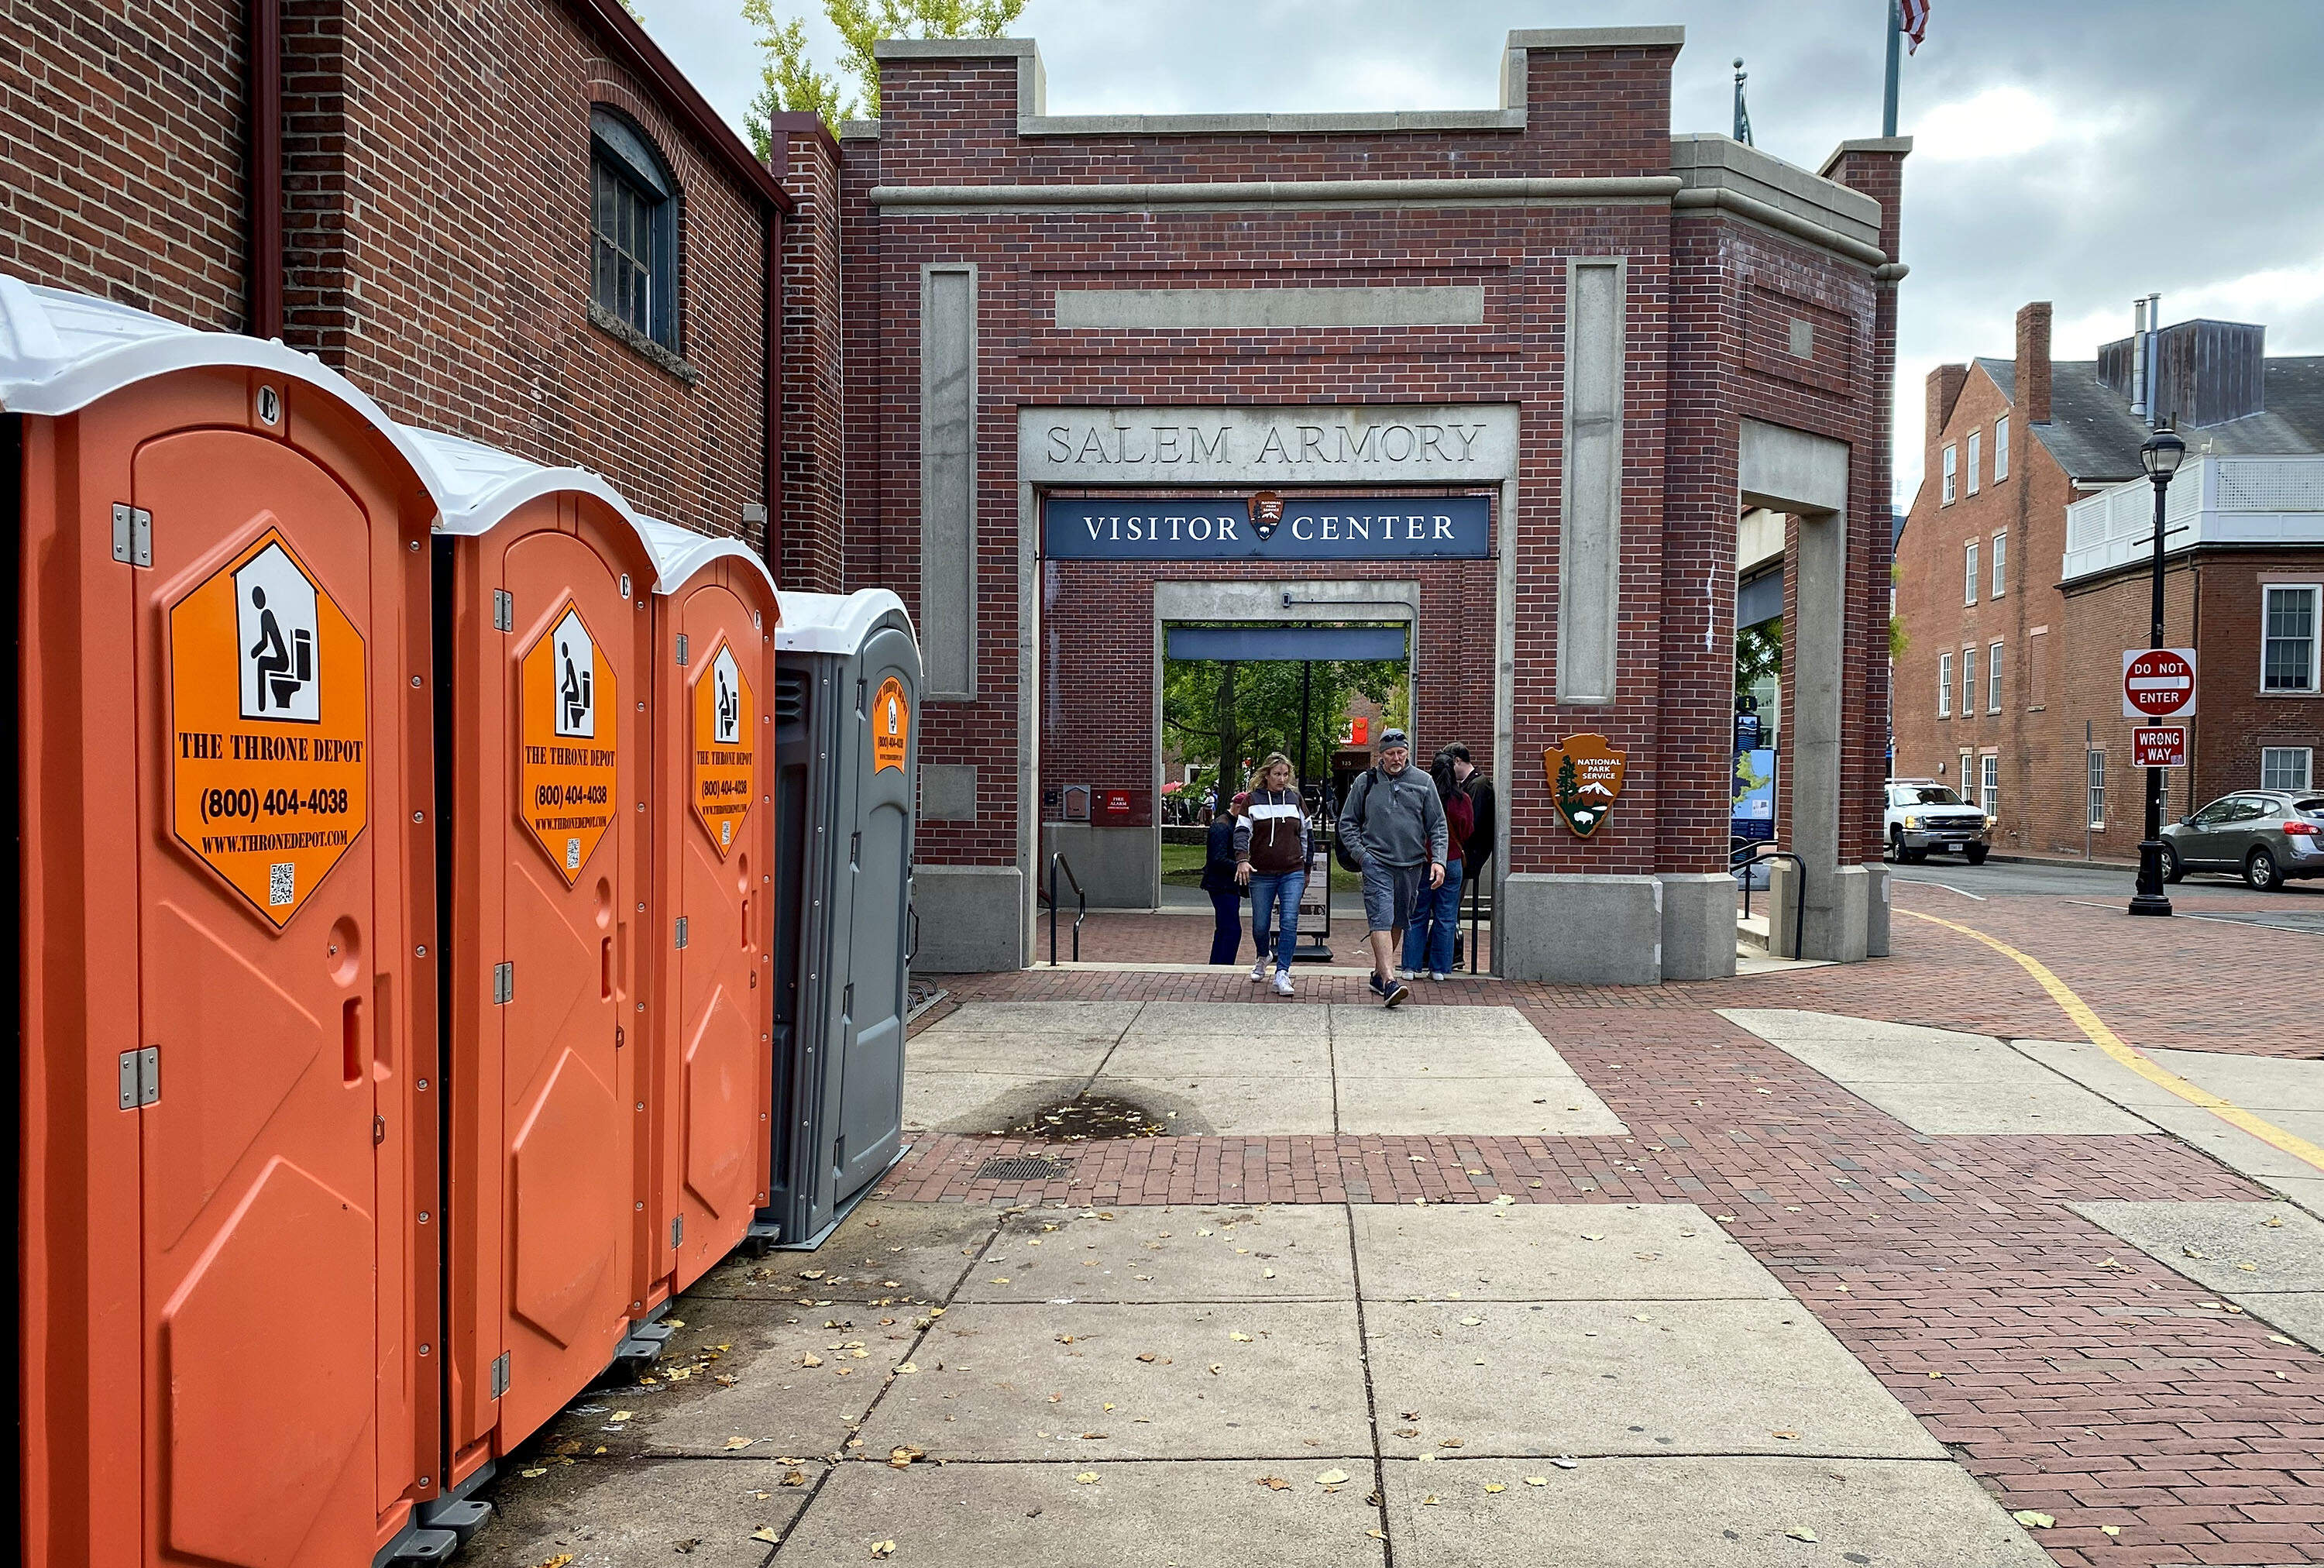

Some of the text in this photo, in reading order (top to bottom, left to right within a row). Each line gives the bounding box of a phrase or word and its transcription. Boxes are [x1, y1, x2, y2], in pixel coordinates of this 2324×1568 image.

[261, 387, 276, 423] E
[1047, 425, 1487, 464] SALEM ARMORY
[1083, 515, 1455, 541] VISITOR CENTER
[621, 576, 629, 596] E
[2134, 662, 2184, 674] DO NOT
[2140, 693, 2179, 703] ENTER
[179, 732, 363, 763] THE THRONE DEPOT
[2139, 732, 2180, 745] WRONG
[525, 745, 615, 766] THE THRONE DEPOT
[696, 751, 752, 765] THE THRONE DEPOT
[2148, 748, 2171, 761] WAY
[535, 784, 607, 810] (800) 404-4038
[702, 780, 720, 799] (800)
[200, 787, 348, 825] (800) 404-4038
[535, 816, 607, 830] WWW.THRONEDEPOT.COM
[201, 830, 348, 854] WWW.THRONEDEPOT.COM
